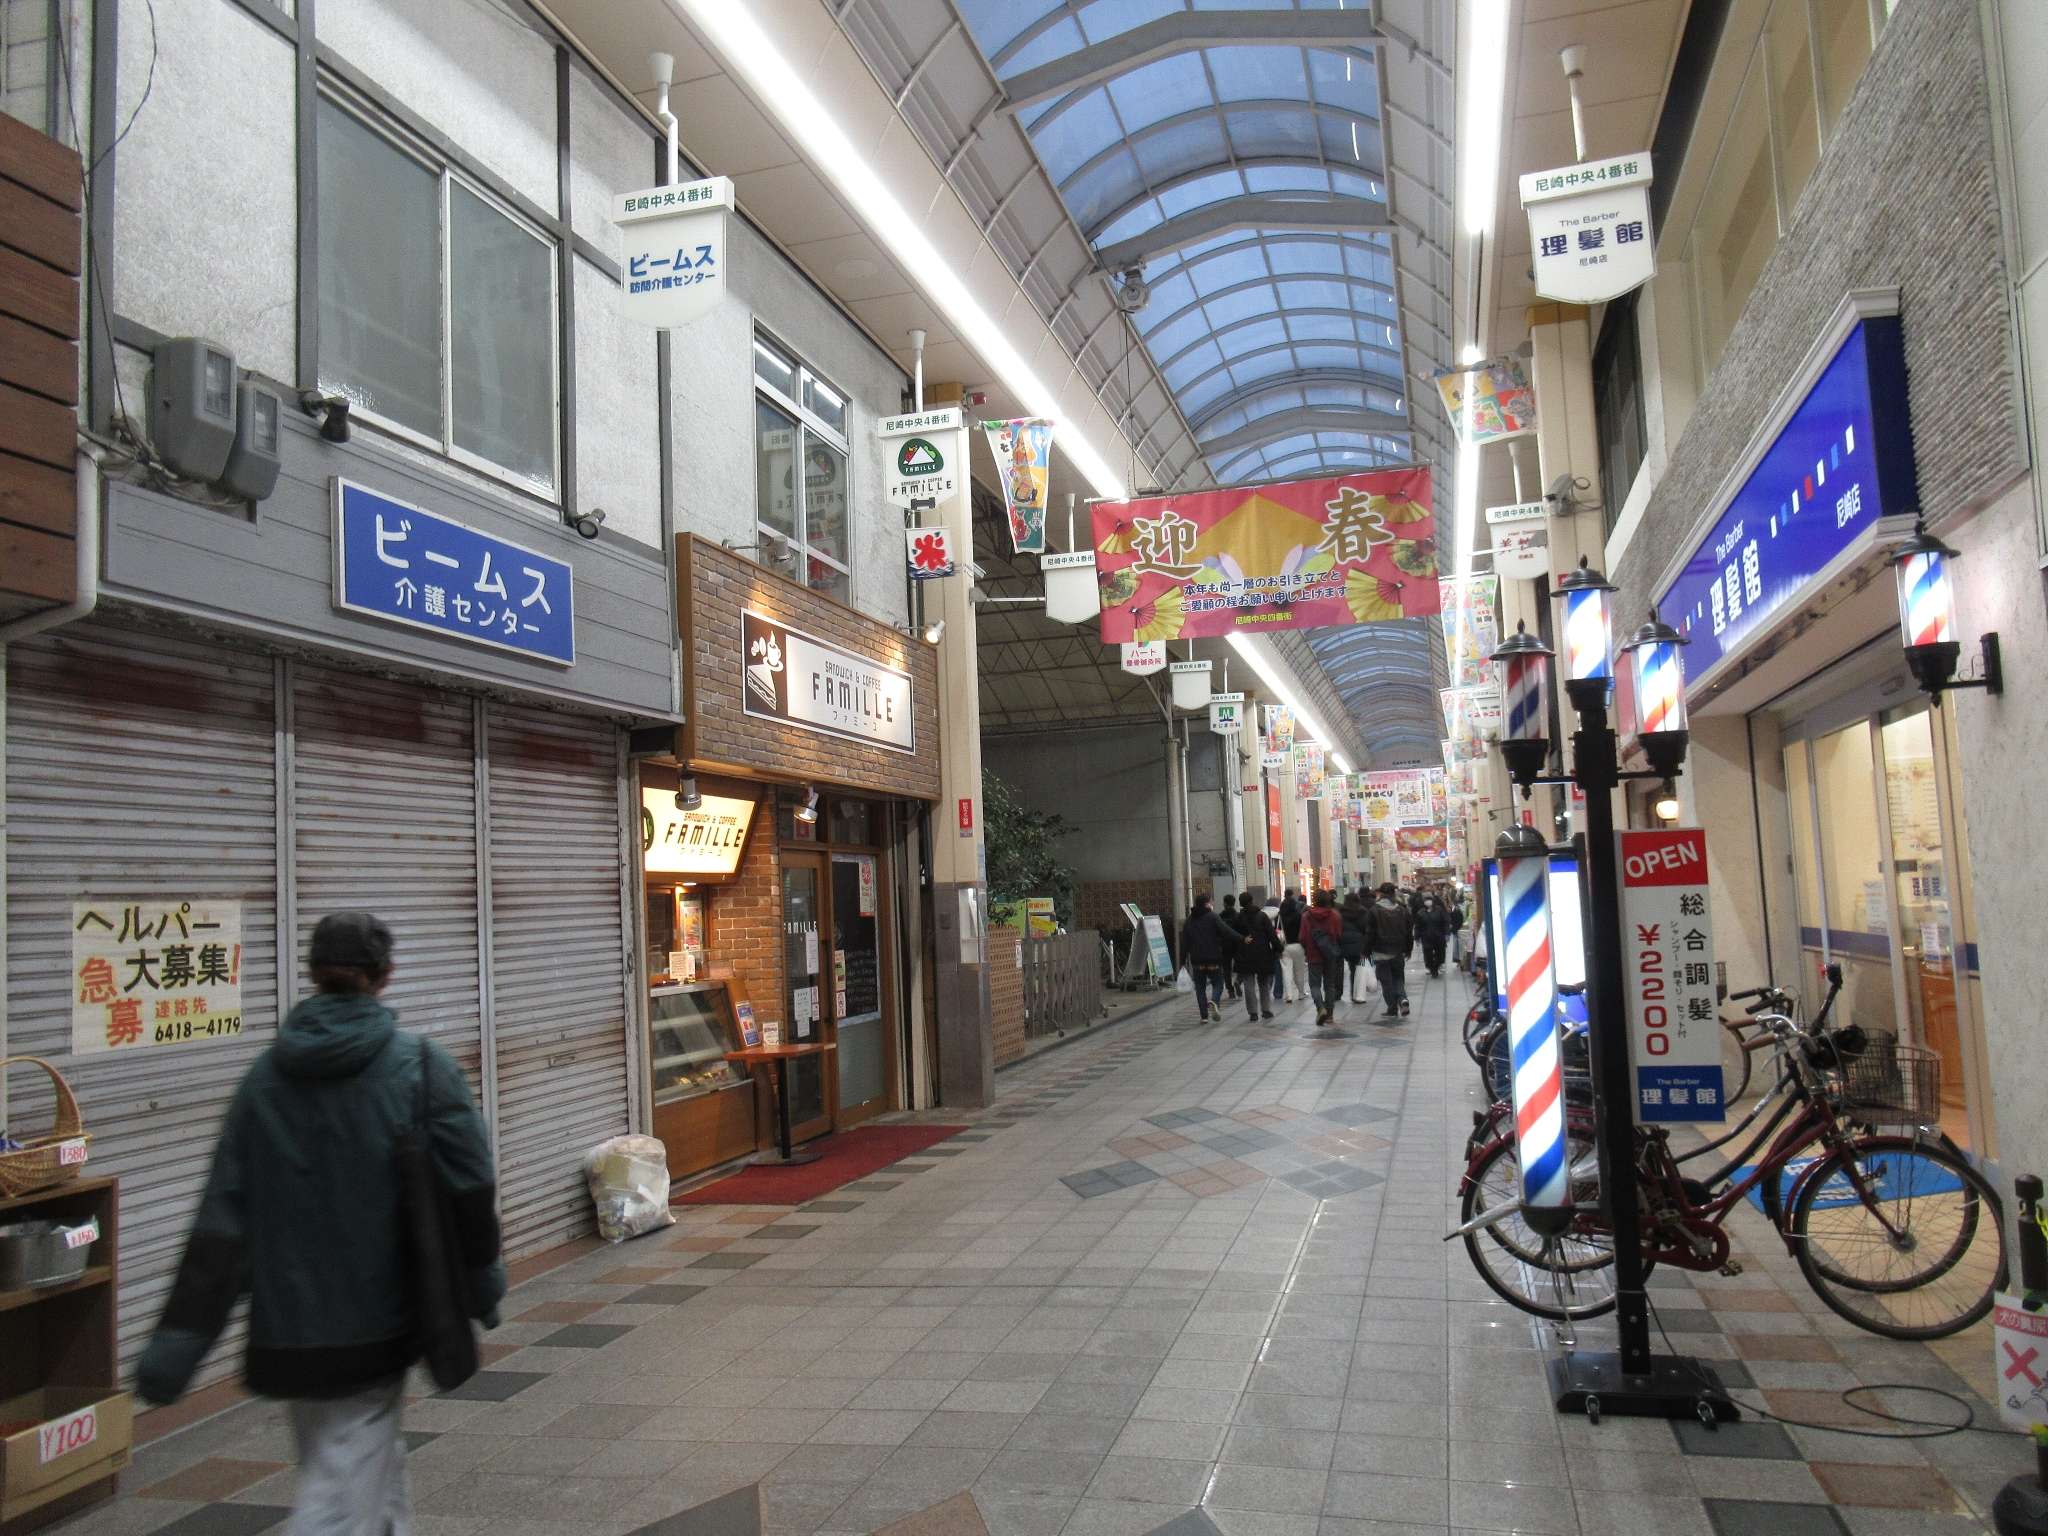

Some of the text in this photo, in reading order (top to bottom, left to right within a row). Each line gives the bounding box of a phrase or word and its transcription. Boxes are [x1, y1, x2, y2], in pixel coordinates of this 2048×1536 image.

[1536, 162, 1638, 192] 尼崎中央4番街
[624, 186, 713, 212] 尼崎中央4番街
[1560, 211, 1620, 227] The Barber
[1540, 221, 1644, 257] 理髪館
[630, 245, 714, 277] ビームス
[1579, 255, 1608, 267] 尼崎店
[630, 272, 716, 294] 訪問介護センター
[886, 414, 950, 431] 尼崎中央4番街
[892, 480, 952, 496] FAMILLE
[1725, 519, 1744, 555] Barber
[375, 513, 551, 614] ビームス
[1179, 584, 1349, 613] ご愛顧の程お願い申し上げます
[1183, 570, 1342, 597] 本年も尚一層のお引き立てと
[395, 577, 540, 635] 介護センター
[812, 672, 893, 722] FAMILLE
[862, 674, 881, 691] COFFEE
[665, 823, 743, 848] FAMILLE
[1625, 840, 1700, 879] OPEN
[76, 902, 221, 944] ヘルパー
[124, 943, 241, 993] 大募集!
[1679, 892, 1713, 1022] 総合調髪
[1637, 923, 1669, 1056] ¥2200
[155, 997, 208, 1019] 連絡先
[43, 1413, 95, 1455] ¥100
